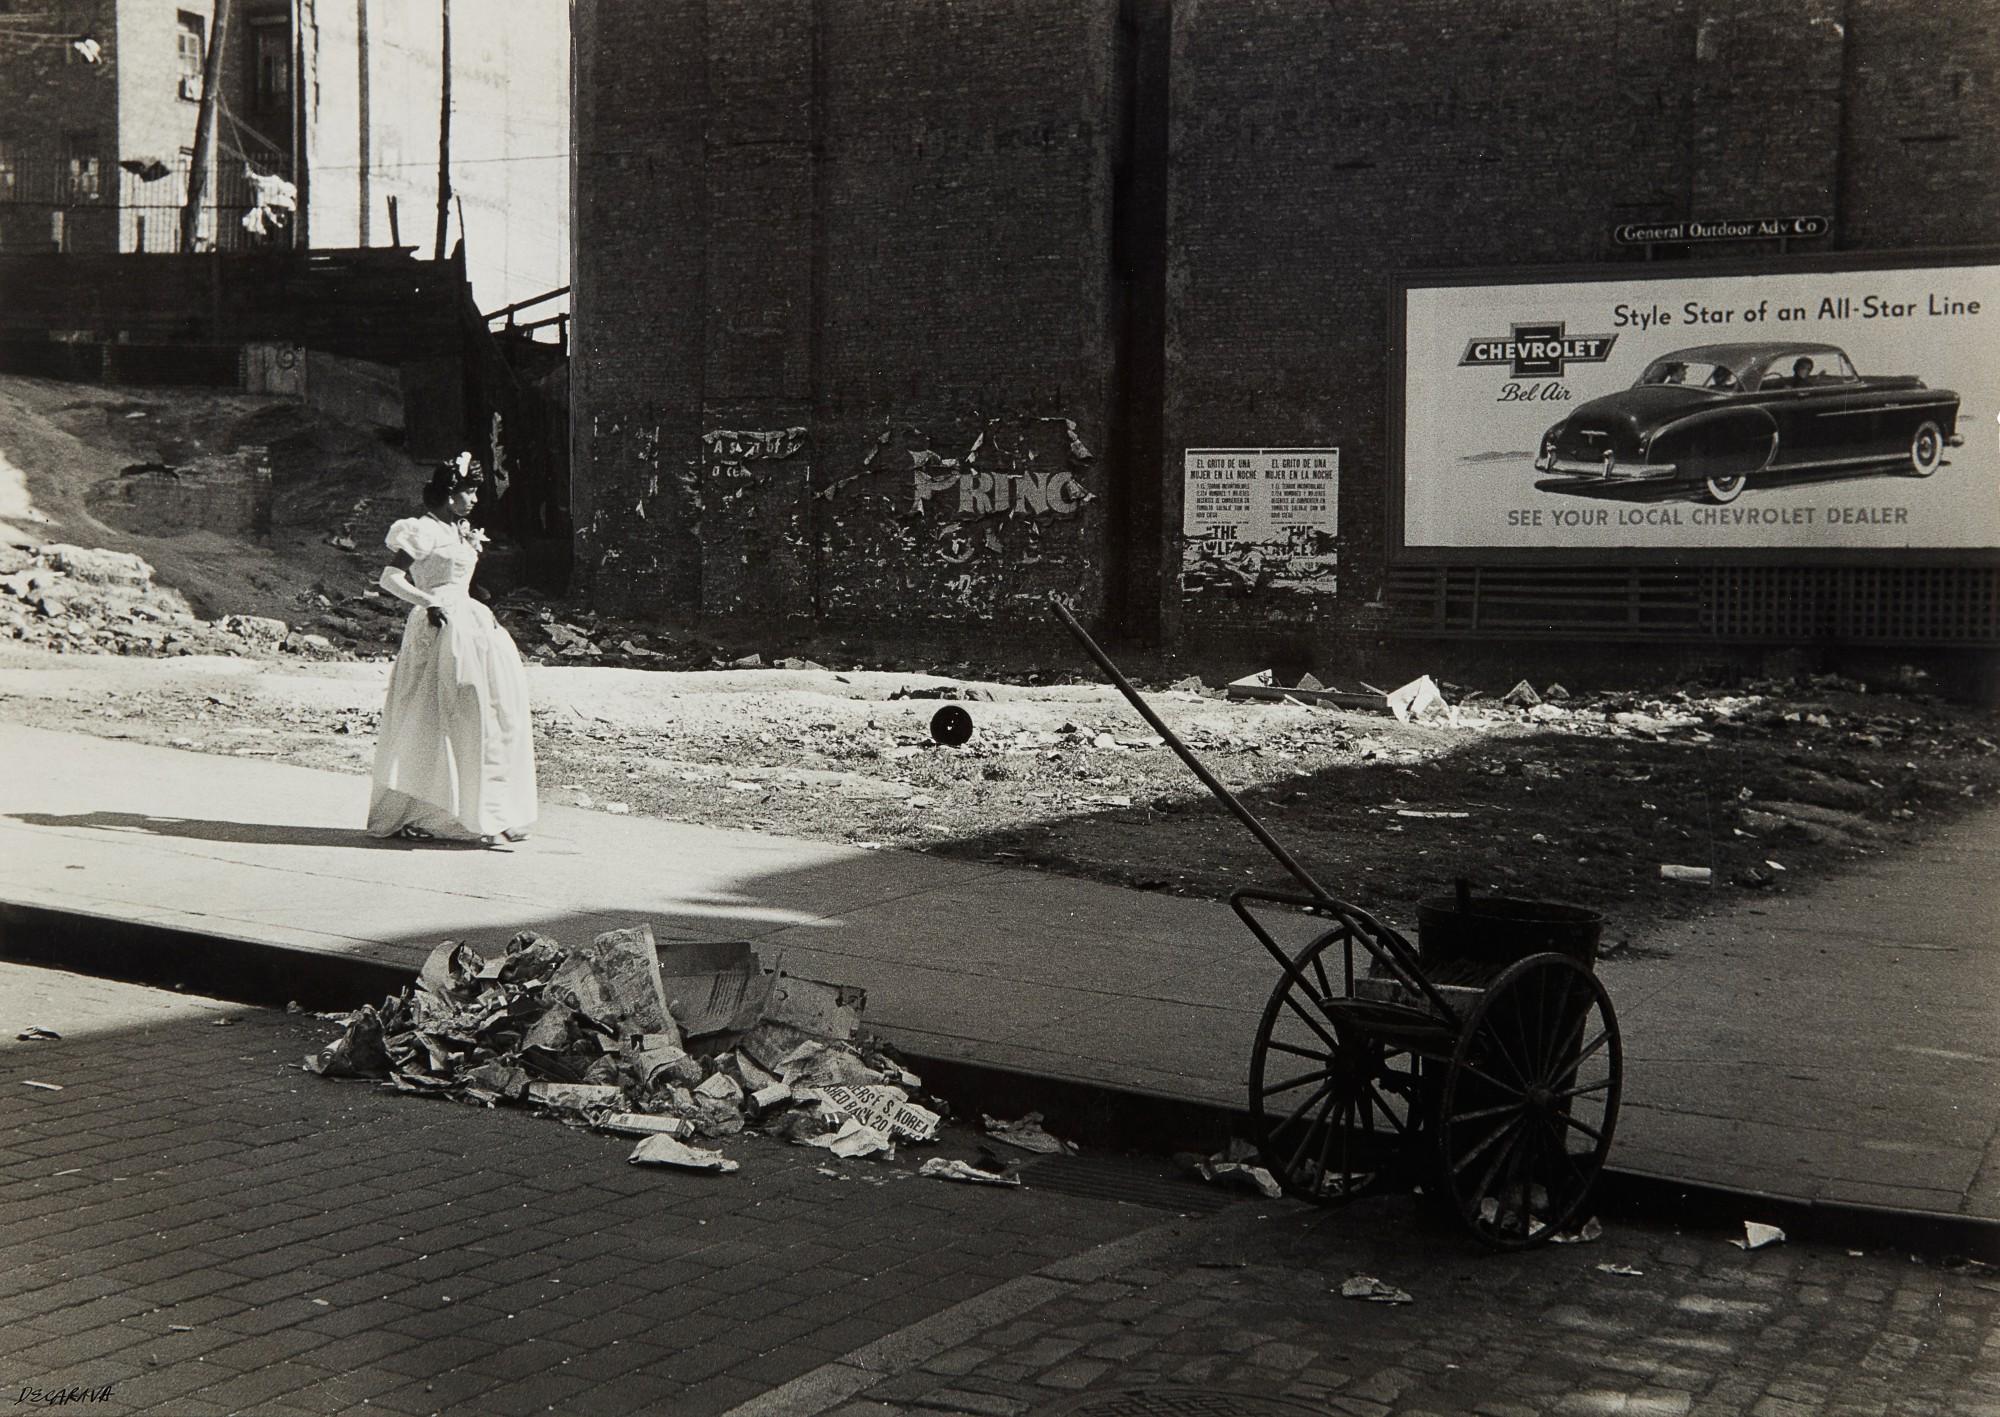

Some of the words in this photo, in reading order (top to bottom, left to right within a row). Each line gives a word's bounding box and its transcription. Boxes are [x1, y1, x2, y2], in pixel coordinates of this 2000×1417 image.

[1623, 224, 1684, 241] General
[1689, 222, 1753, 238] Outdoor
[1758, 220, 1787, 235] Adv
[1794, 218, 1817, 233] Co
[1613, 304, 1672, 331] Style
[1683, 302, 1735, 325] Star
[1743, 300, 1768, 322] of
[1777, 306, 1806, 322] an
[1817, 295, 1917, 319] All-Star
[1929, 293, 1981, 316] Line
[1474, 340, 1600, 361] CHEVROLET
[1496, 382, 1537, 402] Bel
[1540, 381, 1572, 401] Air
[1196, 458, 1205, 468] EL
[1271, 458, 1280, 468] EL
[1507, 509, 1543, 527] SEE
[1551, 509, 1609, 527] YOUR
[1618, 508, 1683, 526] LOCAL
[1692, 506, 1816, 525] CHEVROLET
[1827, 506, 1909, 525] DEALER
[869, 1114, 889, 1132] 20
[882, 1099, 895, 1117] S.
[893, 1107, 930, 1135] KOREA
